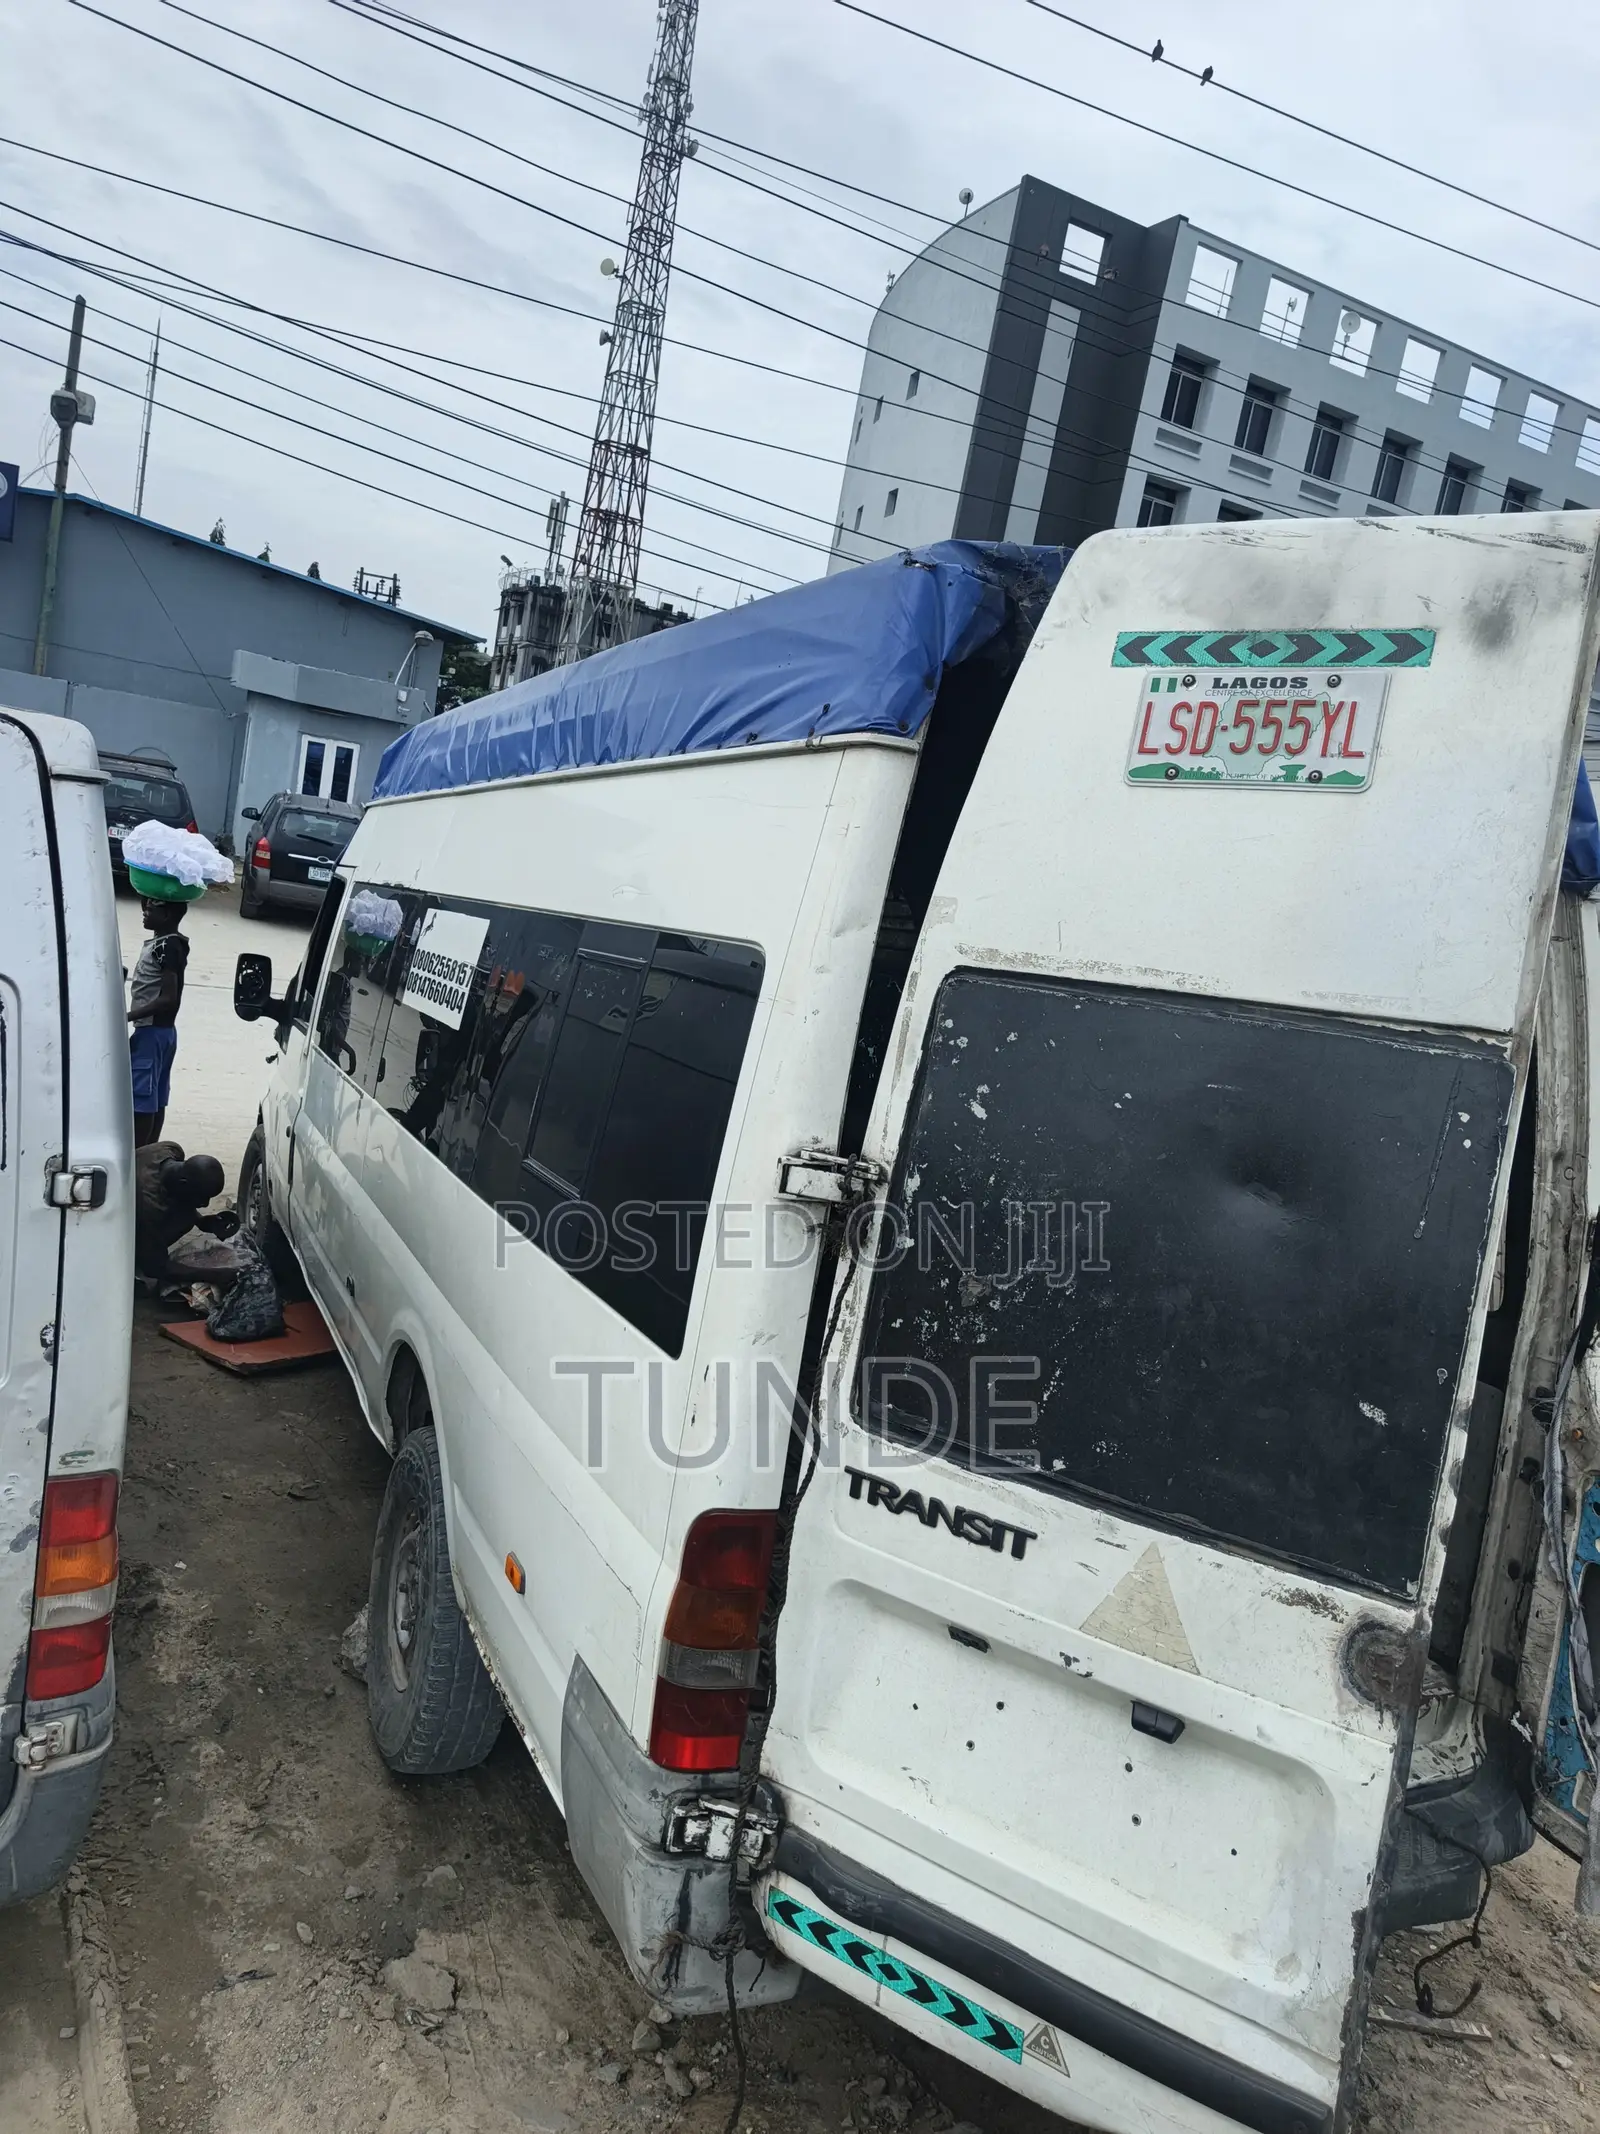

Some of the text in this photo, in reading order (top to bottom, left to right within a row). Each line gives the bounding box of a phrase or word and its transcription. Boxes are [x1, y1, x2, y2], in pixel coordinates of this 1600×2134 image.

[1204, 689, 1313, 697] CENTRE OF EXCELLENCE
[1212, 676, 1308, 689] LAGOS
[1137, 699, 1366, 758] LSD-555YL
[412, 948, 475, 988] 08062558157
[407, 972, 466, 1014] 08147660404
[844, 1465, 1038, 1560] TRANSIT
[1031, 2044, 1058, 2062] CAUTION
[1040, 2035, 1050, 2049] C
